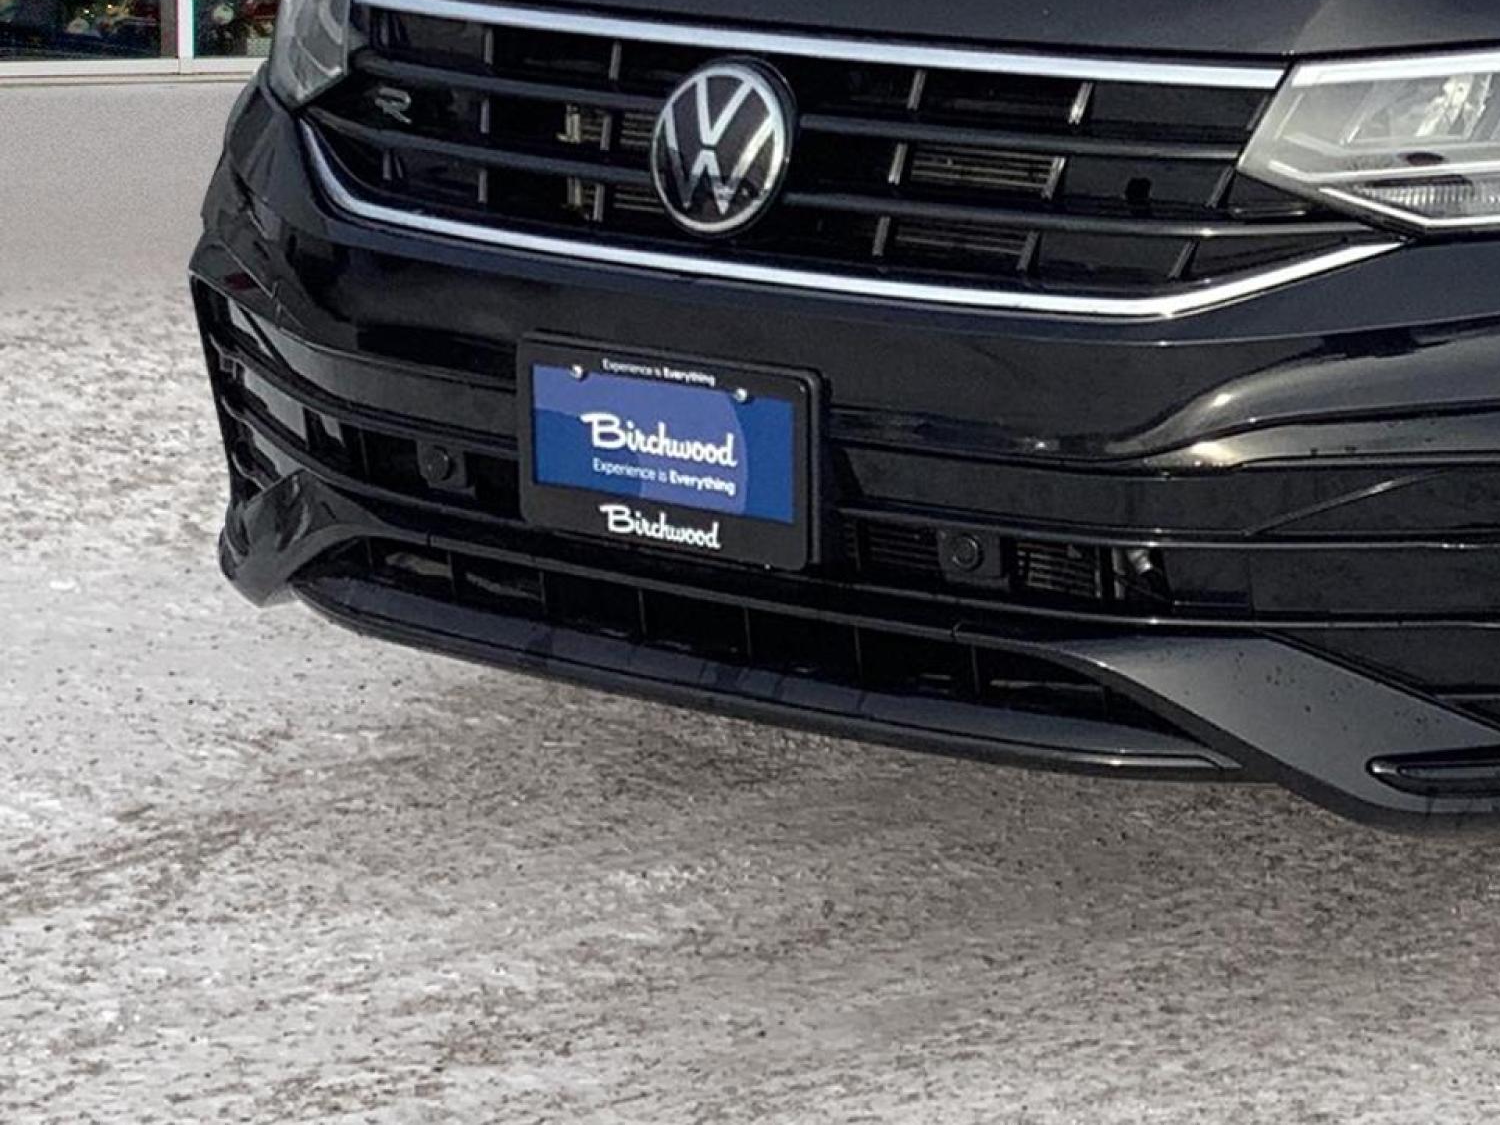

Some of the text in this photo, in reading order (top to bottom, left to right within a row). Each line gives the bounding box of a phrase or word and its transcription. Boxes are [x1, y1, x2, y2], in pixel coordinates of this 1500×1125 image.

[580, 412, 738, 468] Birchwood
[592, 456, 656, 481] Experience
[669, 468, 737, 497] Everything
[600, 503, 722, 550] Birchwood
